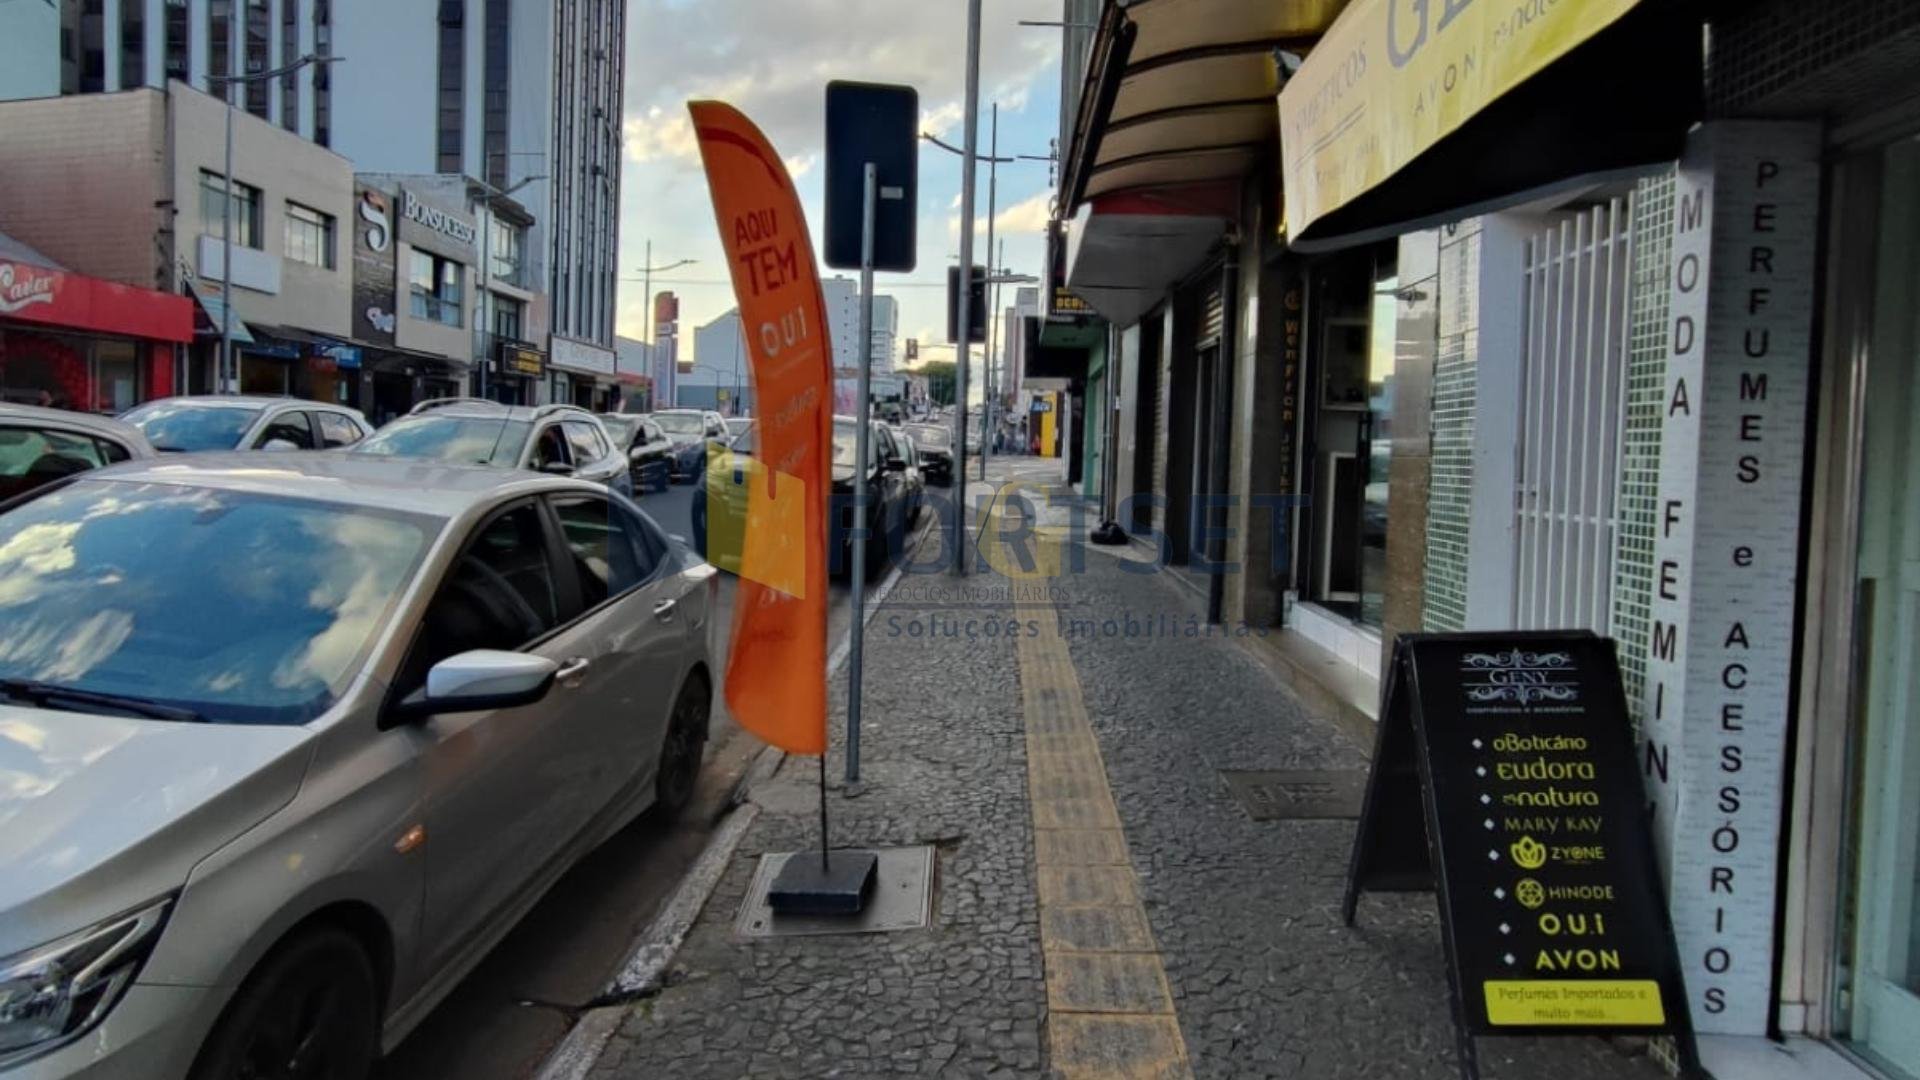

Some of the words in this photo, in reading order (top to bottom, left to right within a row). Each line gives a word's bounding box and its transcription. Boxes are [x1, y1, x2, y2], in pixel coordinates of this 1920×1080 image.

[735, 206, 778, 249] AQUI
[739, 240, 799, 297] TEM
[1669, 189, 1704, 418] MODA
[1736, 161, 1779, 484] PERFUMES
[1733, 545, 1754, 567] e
[1503, 816, 1560, 834] MARY
[1565, 816, 1603, 834] KAY
[1704, 621, 1750, 1015] ACESSÓRIOS
[1549, 886, 1615, 900] HINODE
[1535, 949, 1621, 971] AVON
